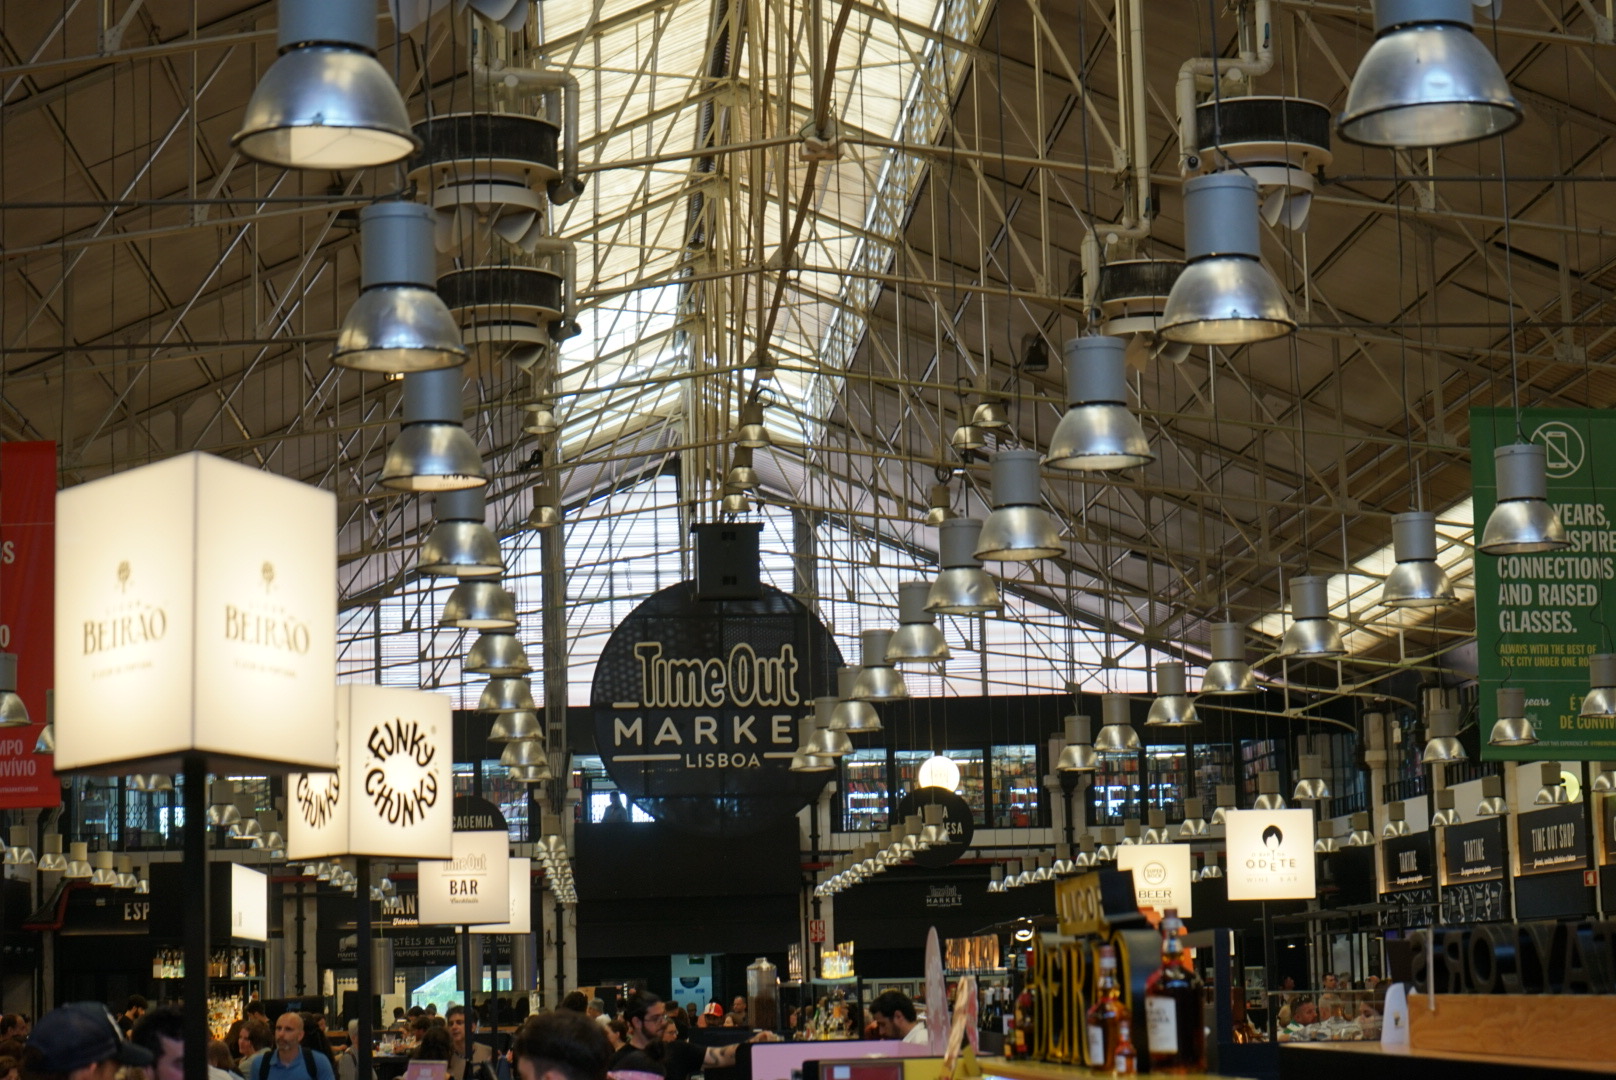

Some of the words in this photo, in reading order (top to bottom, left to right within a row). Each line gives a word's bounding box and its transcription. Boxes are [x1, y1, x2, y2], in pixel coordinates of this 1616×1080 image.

[1497, 556, 1615, 579] CONNECTIONS
[1498, 584, 1532, 605] AND
[1538, 584, 1597, 606] RAISED
[1499, 610, 1577, 633] GLASSES.
[1500, 644, 1527, 654] ALWAYS
[1529, 644, 1549, 654] WITH
[1551, 644, 1564, 654] THE
[1567, 644, 1585, 654] BEST
[1516, 656, 1532, 666] CITY
[1534, 656, 1559, 667] UNDER
[1561, 656, 1576, 667] ONE
[634, 641, 726, 708] Time
[728, 642, 799, 707] Out
[614, 715, 792, 746] MARKE
[1560, 715, 1574, 730] DE
[368, 717, 435, 767] FUNKY
[686, 753, 761, 768] LISBOA
[365, 768, 437, 827] CHUNKY
[1531, 827, 1546, 853] TIME
[1546, 825, 1558, 851] OUT
[1559, 822, 1575, 848] SHOP
[1245, 858, 1297, 872] ODETE
[449, 879, 478, 895] BAR
[1138, 890, 1172, 898] BEER
